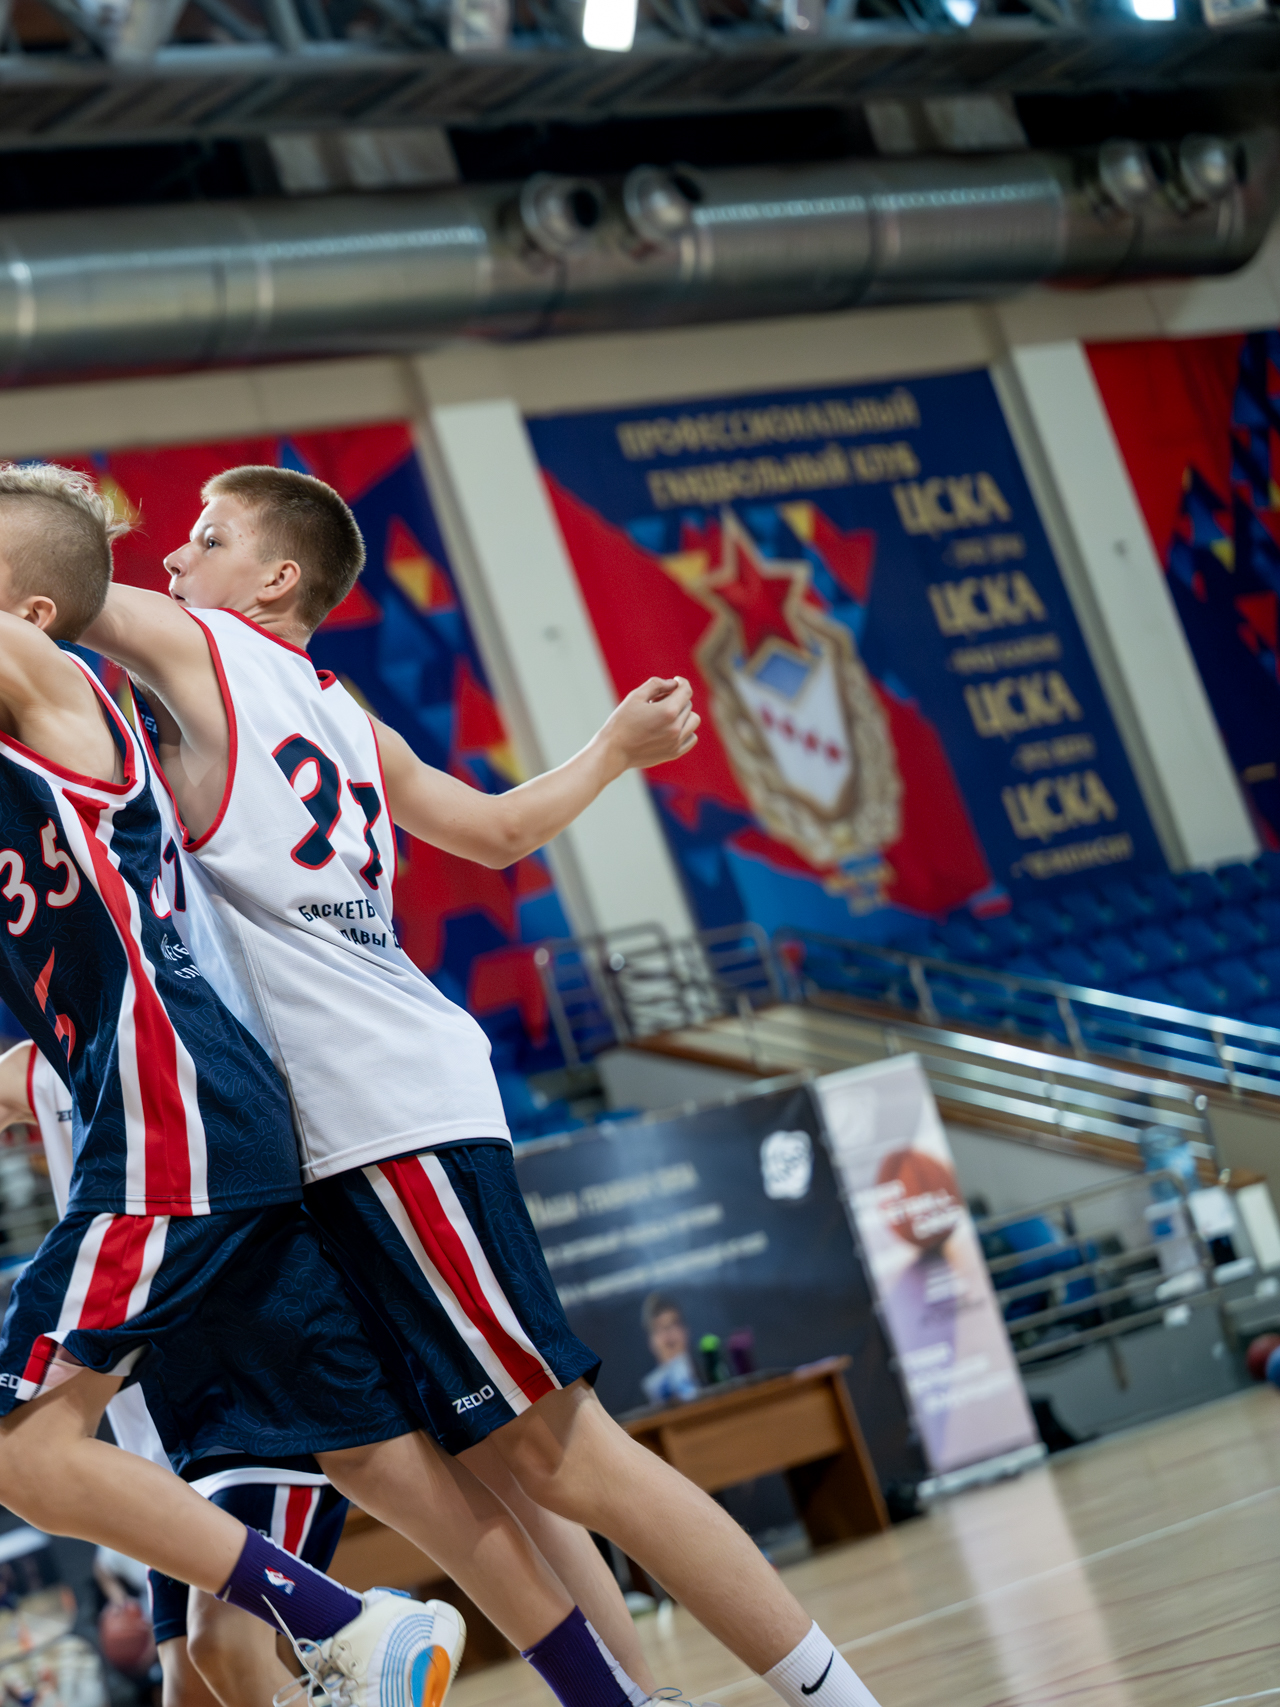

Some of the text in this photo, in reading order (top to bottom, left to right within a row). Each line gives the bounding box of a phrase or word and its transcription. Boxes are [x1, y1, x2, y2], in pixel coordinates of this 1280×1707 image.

[892, 471, 1012, 541] ЦСКА
[927, 569, 1048, 641] ЦСКА
[963, 669, 1083, 743] ЦСКА
[1001, 769, 1118, 844] ЦСКА
[451, 1384, 495, 1414] ZEDO
